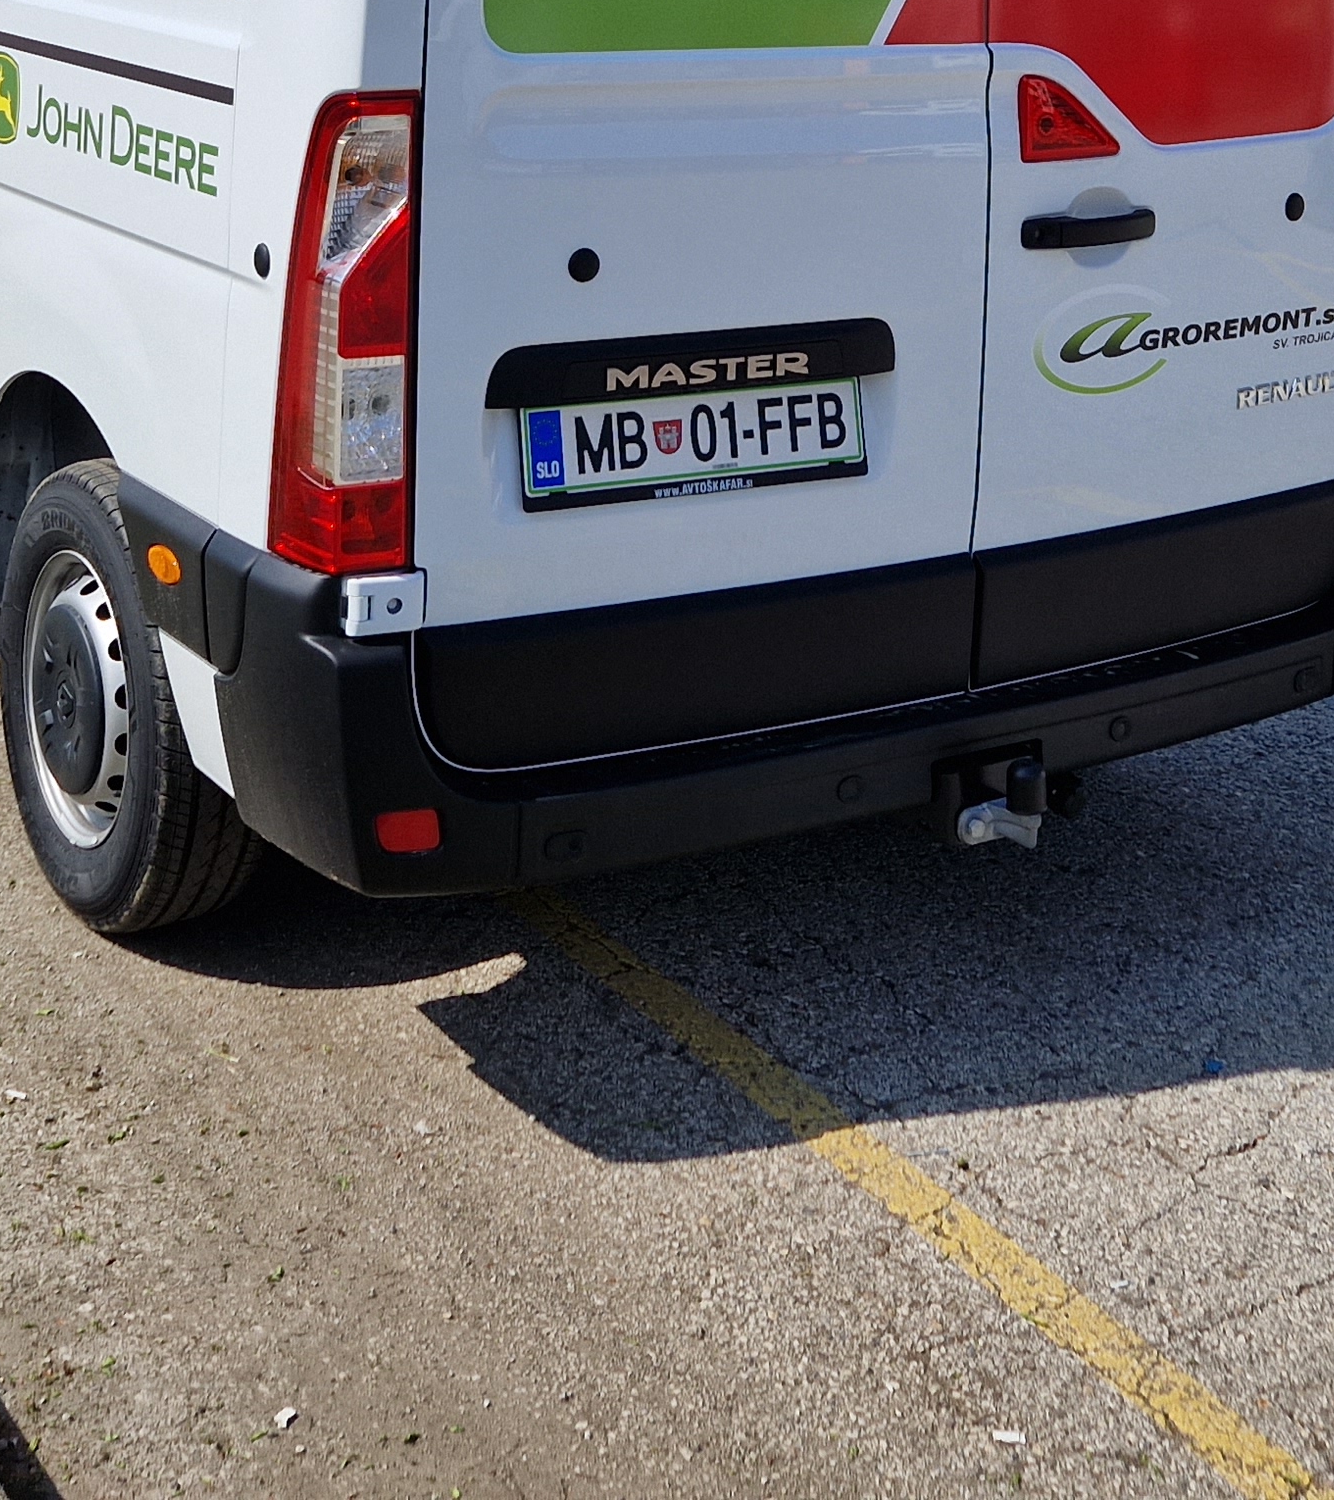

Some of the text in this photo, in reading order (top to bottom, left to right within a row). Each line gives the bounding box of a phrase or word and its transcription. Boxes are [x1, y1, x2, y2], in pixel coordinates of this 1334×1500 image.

[26, 83, 219, 198] JOHN DEERE
[1272, 338, 1290, 350] SV.
[605, 351, 810, 393] MASTER
[574, 392, 847, 476] MB 01-FFB
[536, 460, 560, 480] SLO
